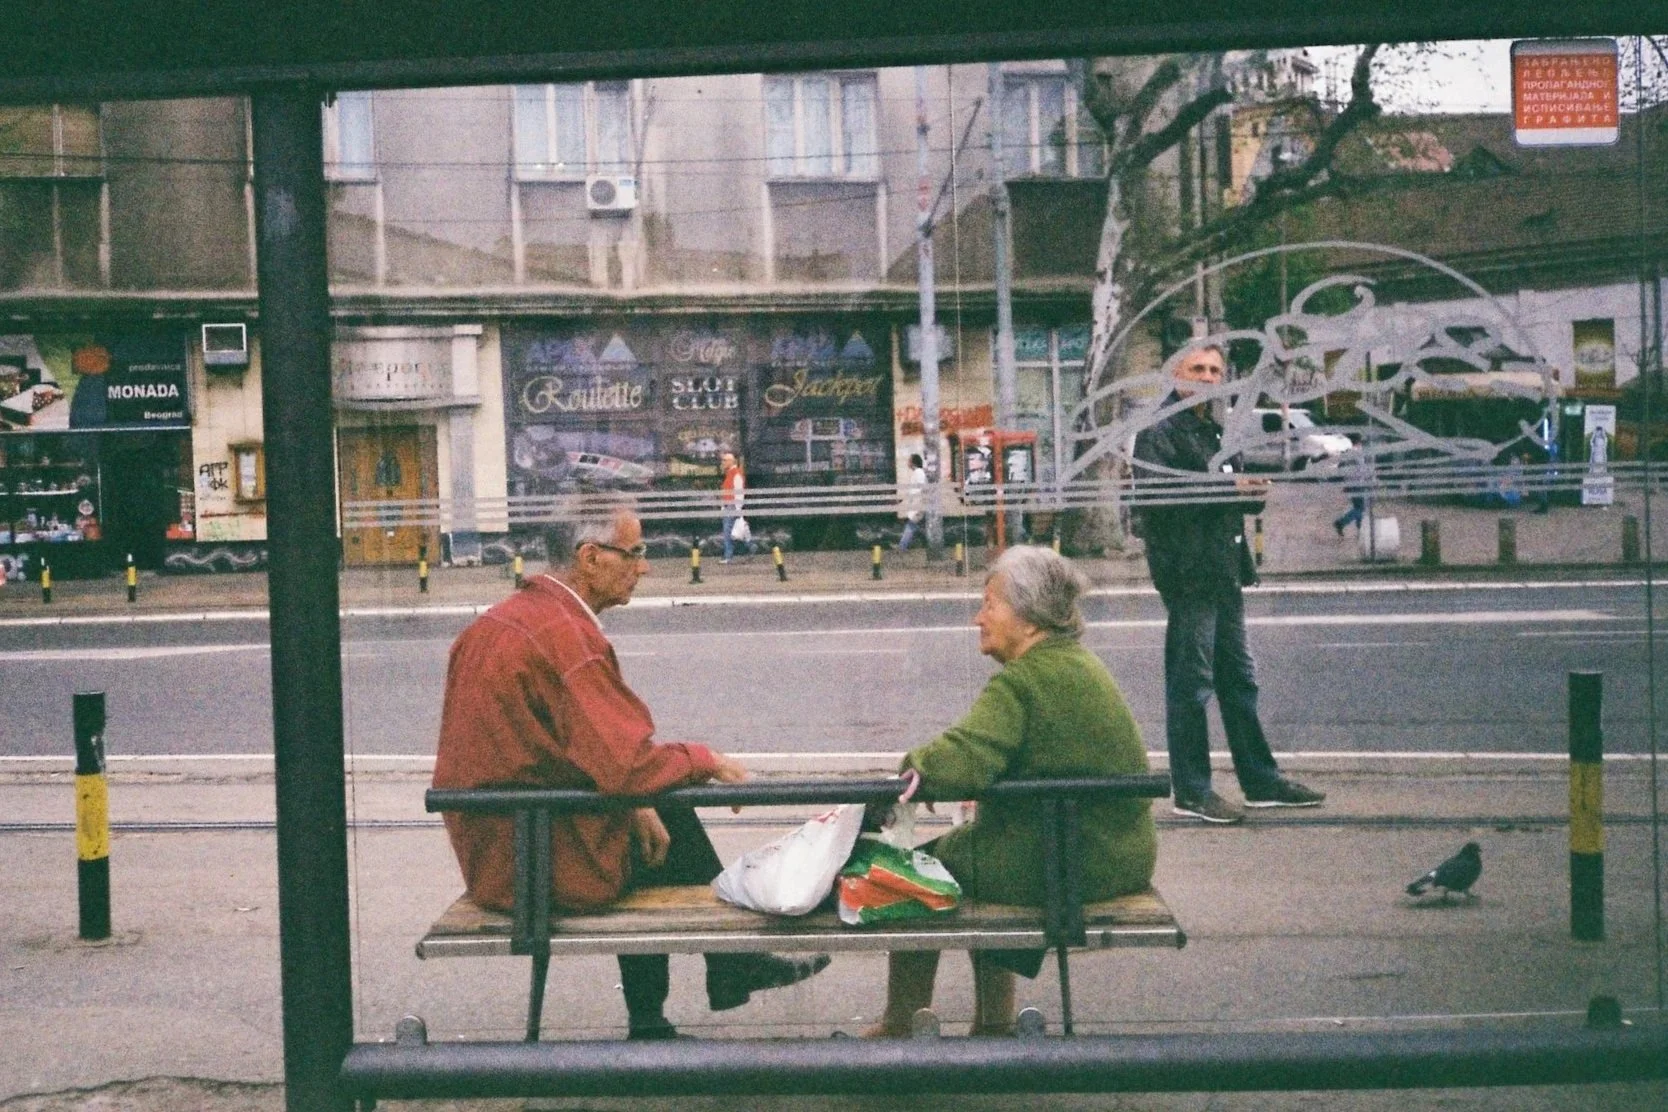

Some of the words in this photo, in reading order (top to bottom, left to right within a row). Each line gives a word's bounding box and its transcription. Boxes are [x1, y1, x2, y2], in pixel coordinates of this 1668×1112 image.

[1523, 91, 1594, 102] МАТЕРИЈАЛА
[1603, 91, 1611, 101] И
[1523, 102, 1611, 113] ИСПИСИВАЊЕ
[1523, 114, 1611, 125] ГРАФИТА
[107, 383, 179, 399] MONADA
[671, 377, 736, 394] SLOT
[764, 368, 884, 408] Jackpot
[519, 375, 642, 414] Roulette
[672, 394, 739, 411] CLUB
